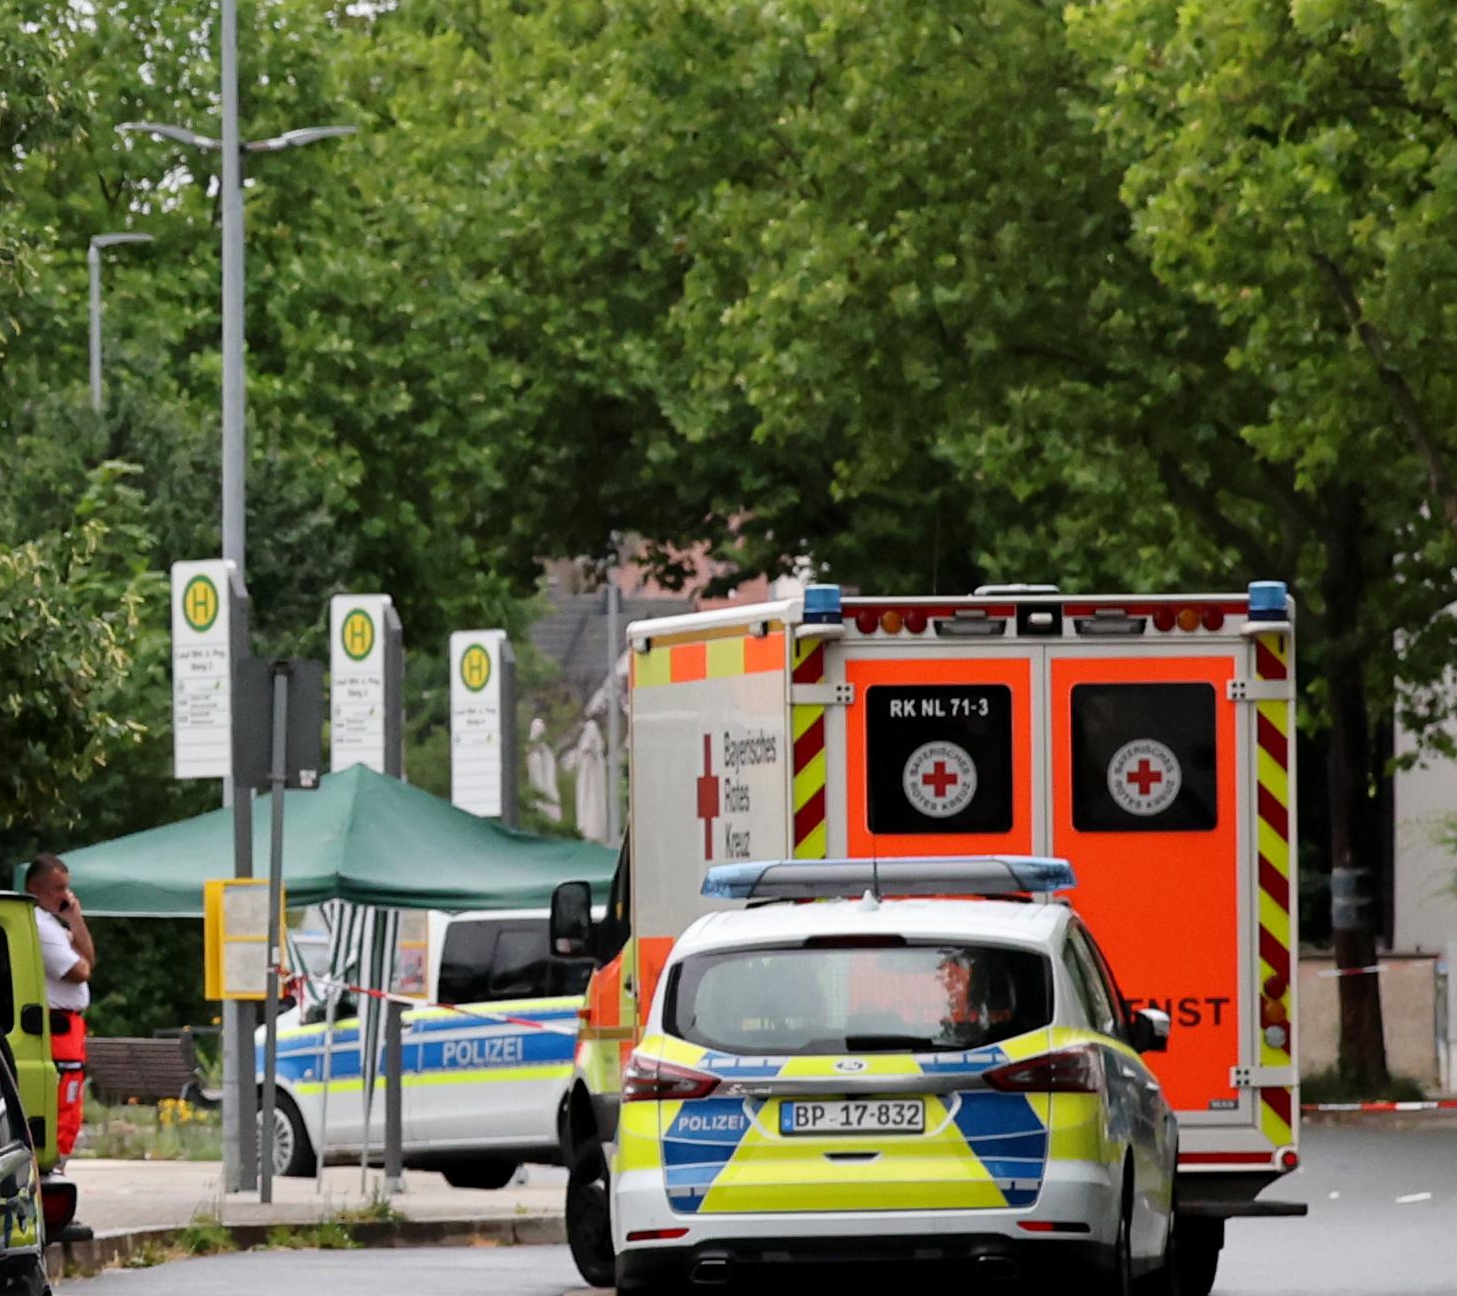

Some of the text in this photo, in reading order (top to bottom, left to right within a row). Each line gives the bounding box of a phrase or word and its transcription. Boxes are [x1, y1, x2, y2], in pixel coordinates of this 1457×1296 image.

[889, 696, 990, 718] RK NL 71-3
[442, 1036, 524, 1066] POLIZEI
[678, 1115, 745, 1131] POLIZEI
[795, 1106, 825, 1126] BP
[839, 1104, 921, 1126] 17-832
